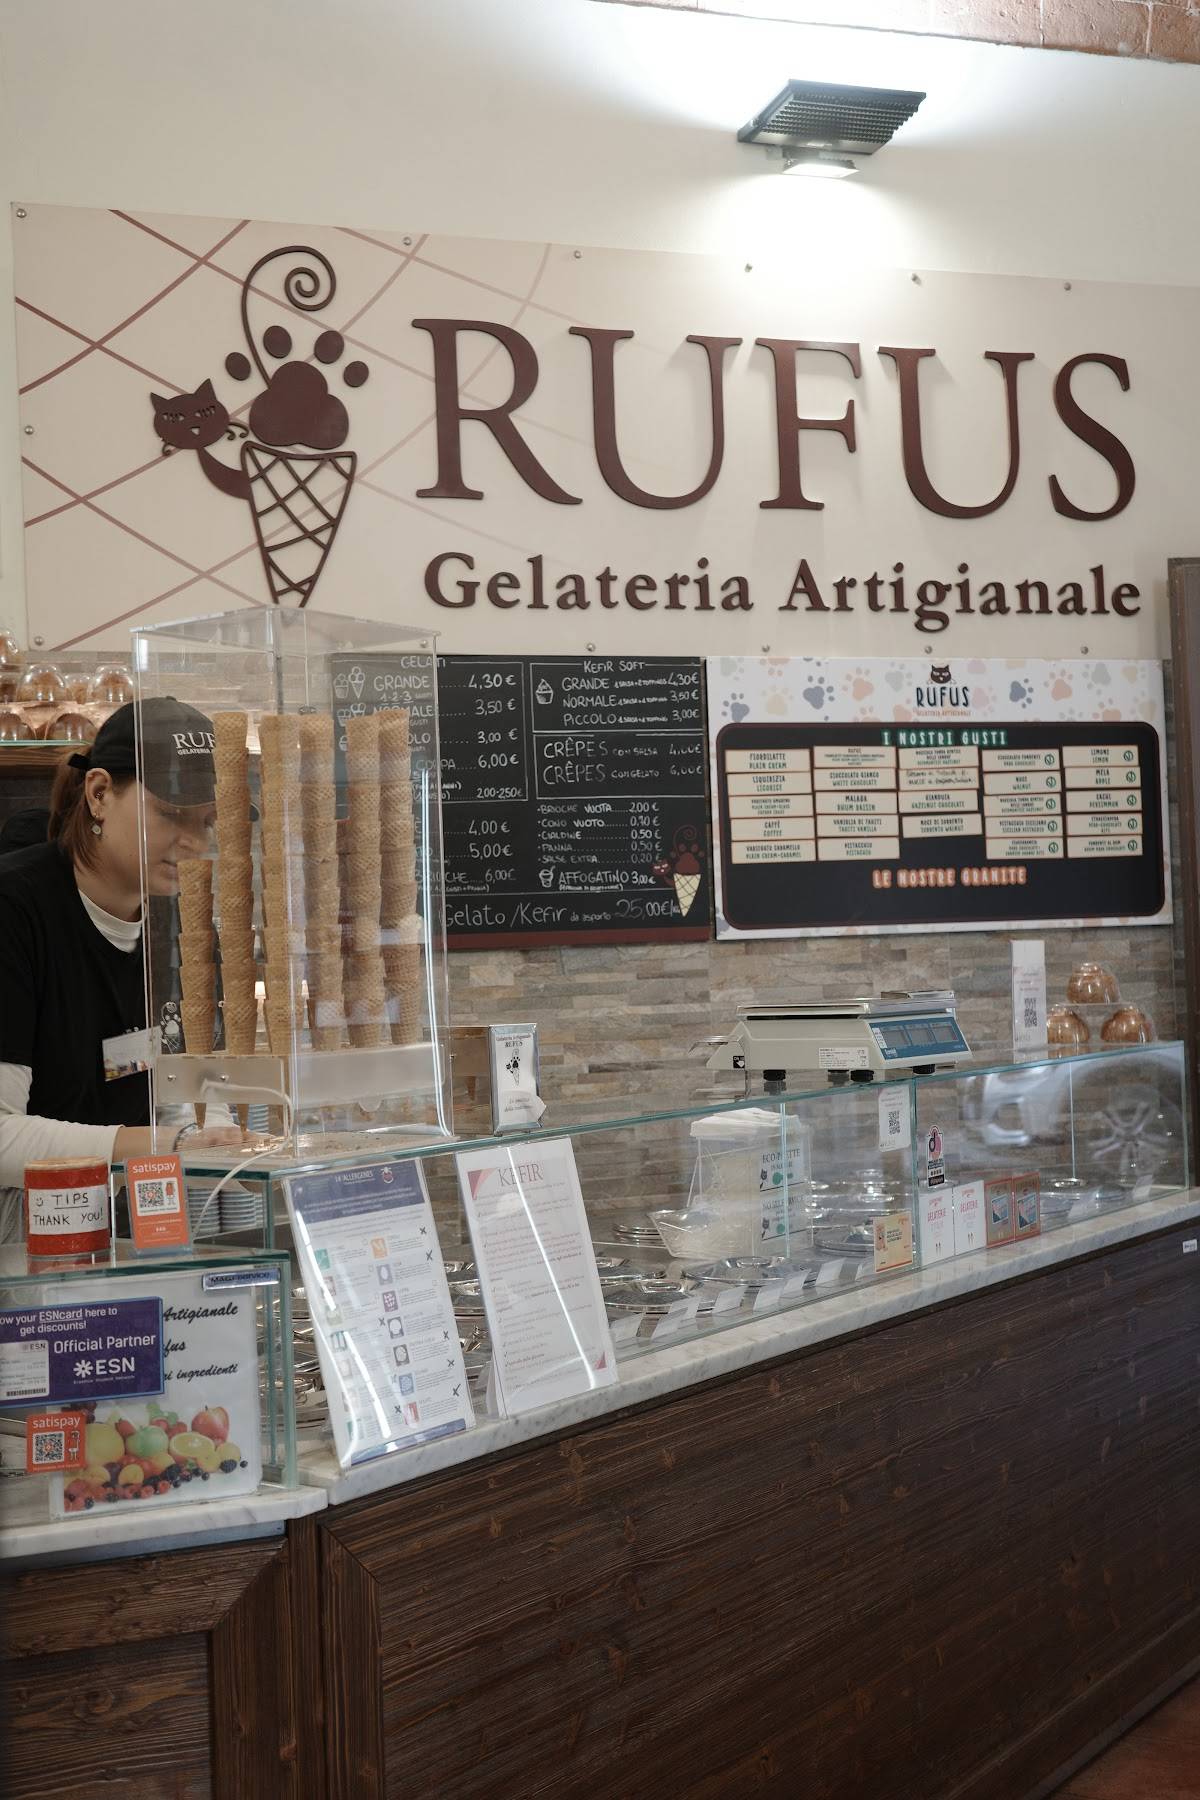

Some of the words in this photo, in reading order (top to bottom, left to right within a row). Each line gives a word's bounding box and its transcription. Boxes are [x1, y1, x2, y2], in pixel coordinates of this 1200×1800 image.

[411, 318, 1136, 522] RUFUS
[423, 551, 754, 611] Gelateria
[778, 558, 1142, 633] Artigianale
[619, 661, 645, 672] SOFT
[374, 675, 430, 691] GRANDE
[469, 674, 502, 689] 4,30
[562, 677, 610, 692] GRANDE
[563, 694, 617, 708] NORMALE
[916, 686, 969, 708] RUFUS
[475, 700, 503, 716] 3,50
[564, 714, 617, 726] PICCOLO
[172, 731, 216, 749] RUF
[478, 731, 502, 744] 3,00
[884, 731, 890, 746] I
[899, 732, 953, 746] NOSTRI
[962, 731, 1006, 745] GUSTI
[544, 737, 609, 758] CRÊPES
[479, 753, 508, 769] 6,00
[544, 761, 606, 785] CRÊPES
[559, 868, 629, 886] AFFOGATINO
[873, 870, 891, 889] LE
[897, 868, 956, 888] NOSTRE
[962, 866, 1027, 887] GRANITE
[132, 1161, 176, 1174] satispay
[498, 1163, 544, 1187] KEFIR
[54, 1192, 90, 1206] TIPS
[33, 1213, 71, 1226] THANK
[81, 1207, 104, 1223] YOU!
[0, 1316, 13, 1325] ow
[16, 1315, 37, 1326] your
[39, 1308, 83, 1320] ESNcard
[85, 1307, 106, 1318] here
[108, 1308, 118, 1316] to
[164, 1302, 239, 1325] Artigianale
[20, 1327, 35, 1337] get
[38, 1321, 87, 1333] discounts!
[54, 1337, 103, 1354] Official
[107, 1335, 157, 1349] Partner
[164, 1339, 186, 1358] fus
[96, 1357, 136, 1375] ESN
[176, 1363, 239, 1383] ingredienti
[32, 1415, 81, 1430] satispay
